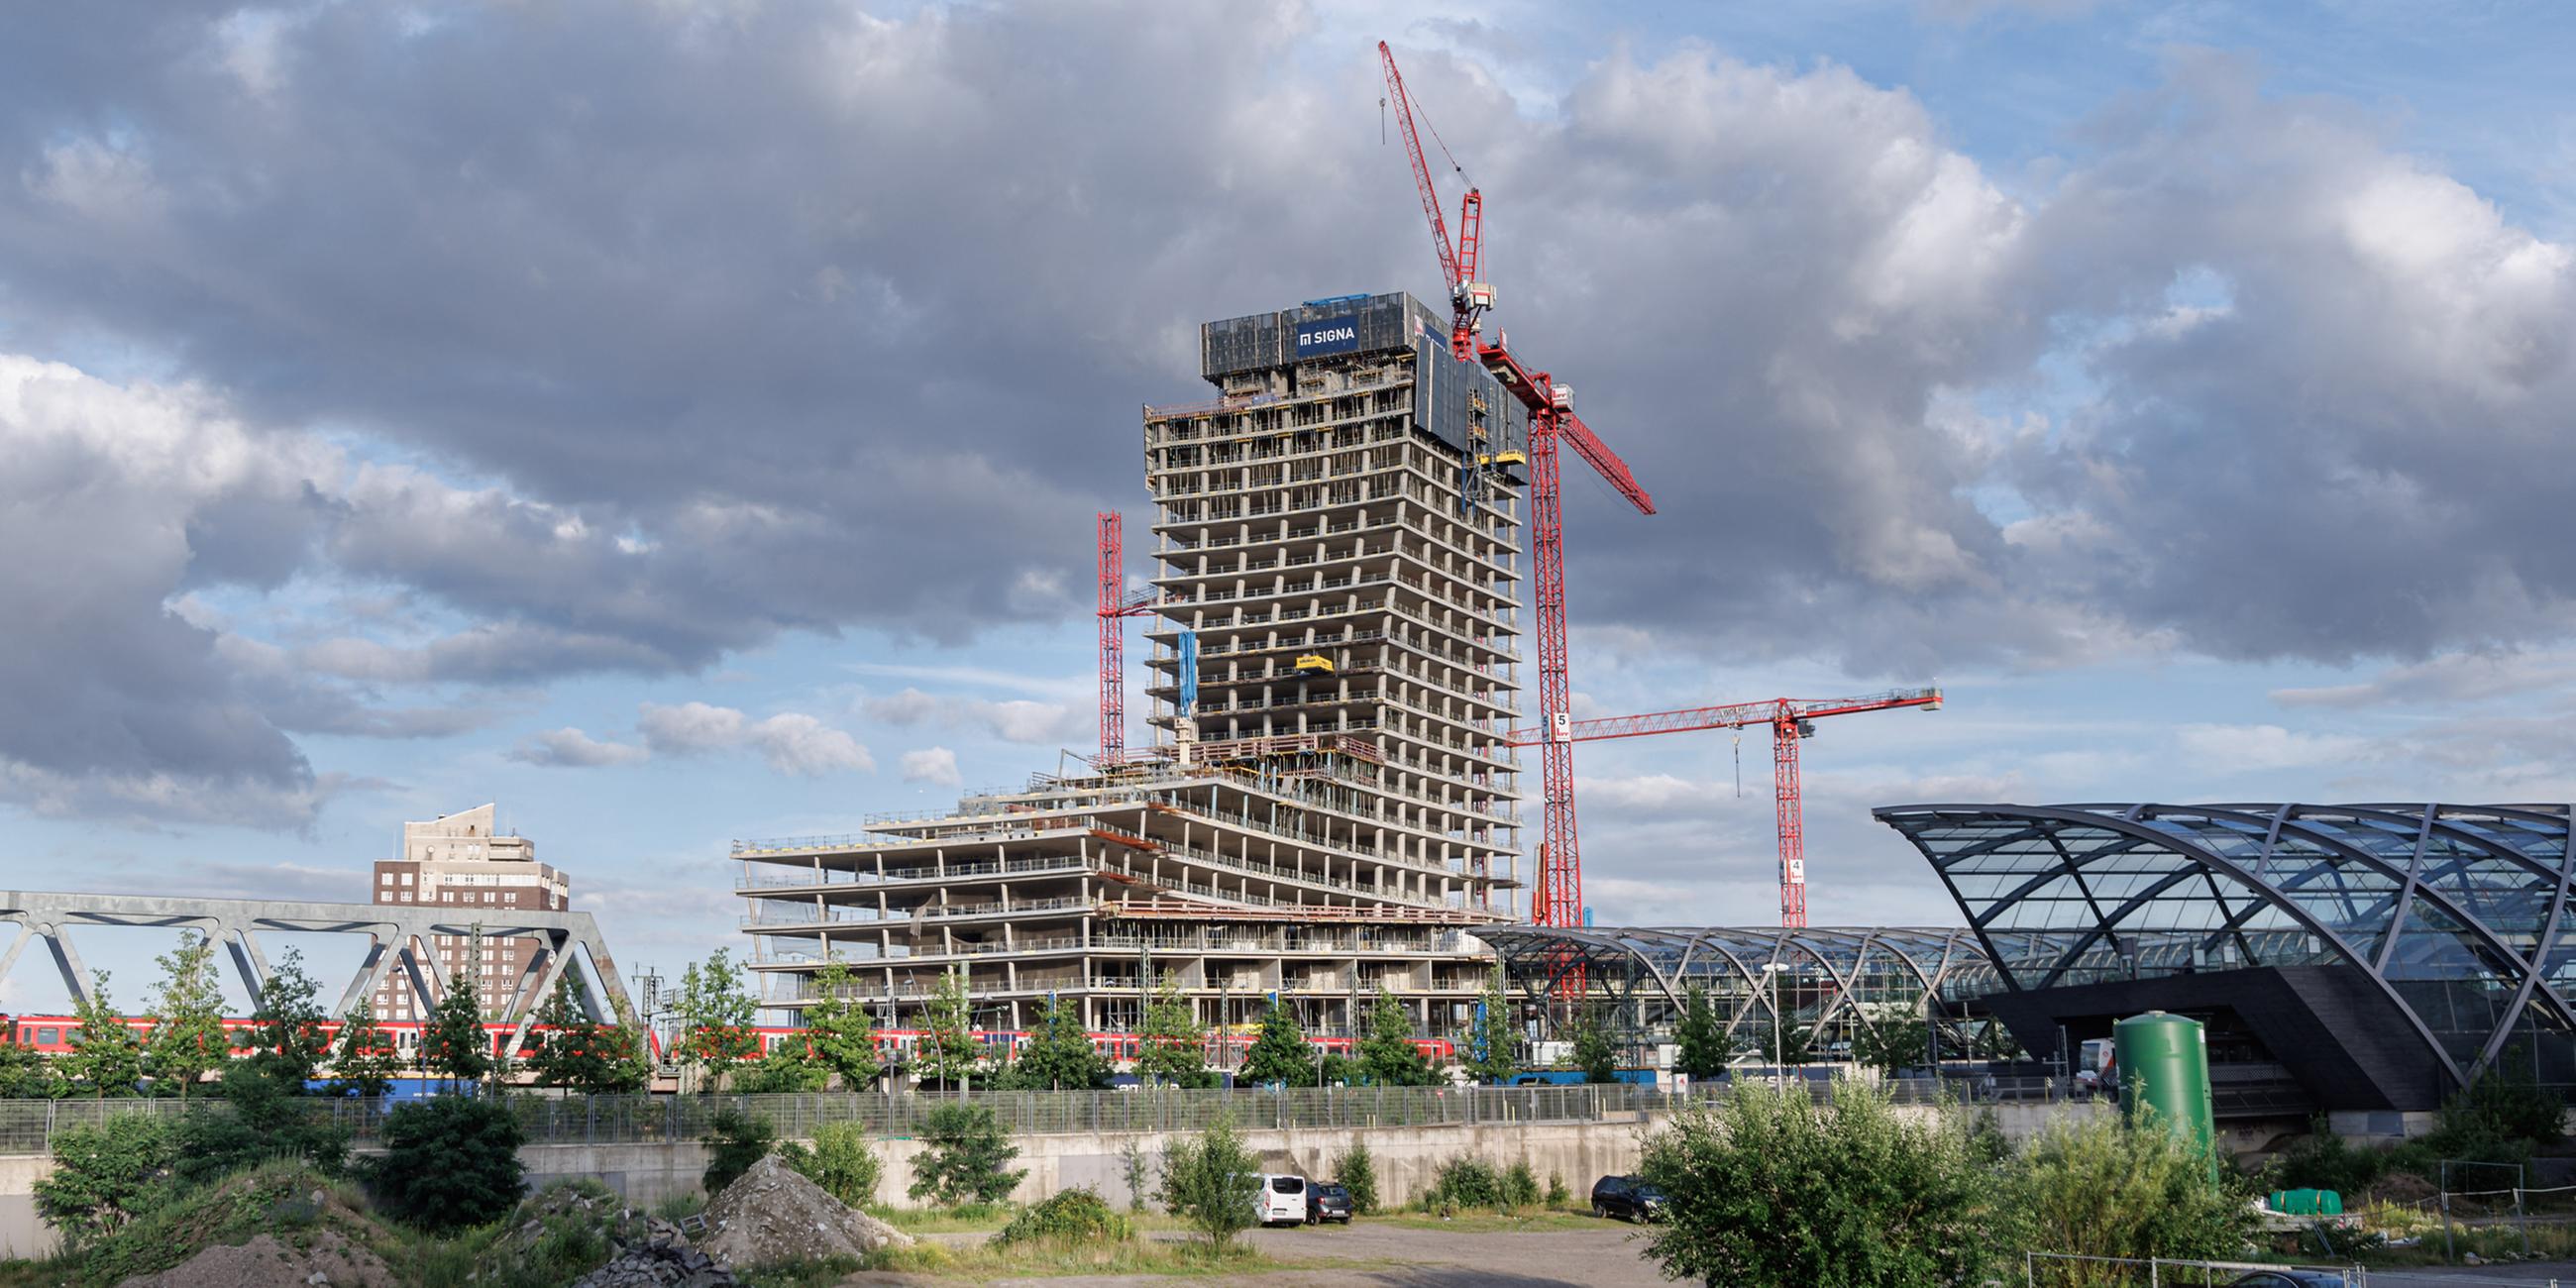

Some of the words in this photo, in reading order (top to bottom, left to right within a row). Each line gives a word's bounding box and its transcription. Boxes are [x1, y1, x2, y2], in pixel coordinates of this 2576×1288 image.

[1314, 327, 1355, 344] SIGNA
[1558, 715, 1566, 725] 5
[1793, 861, 1800, 869] 4
